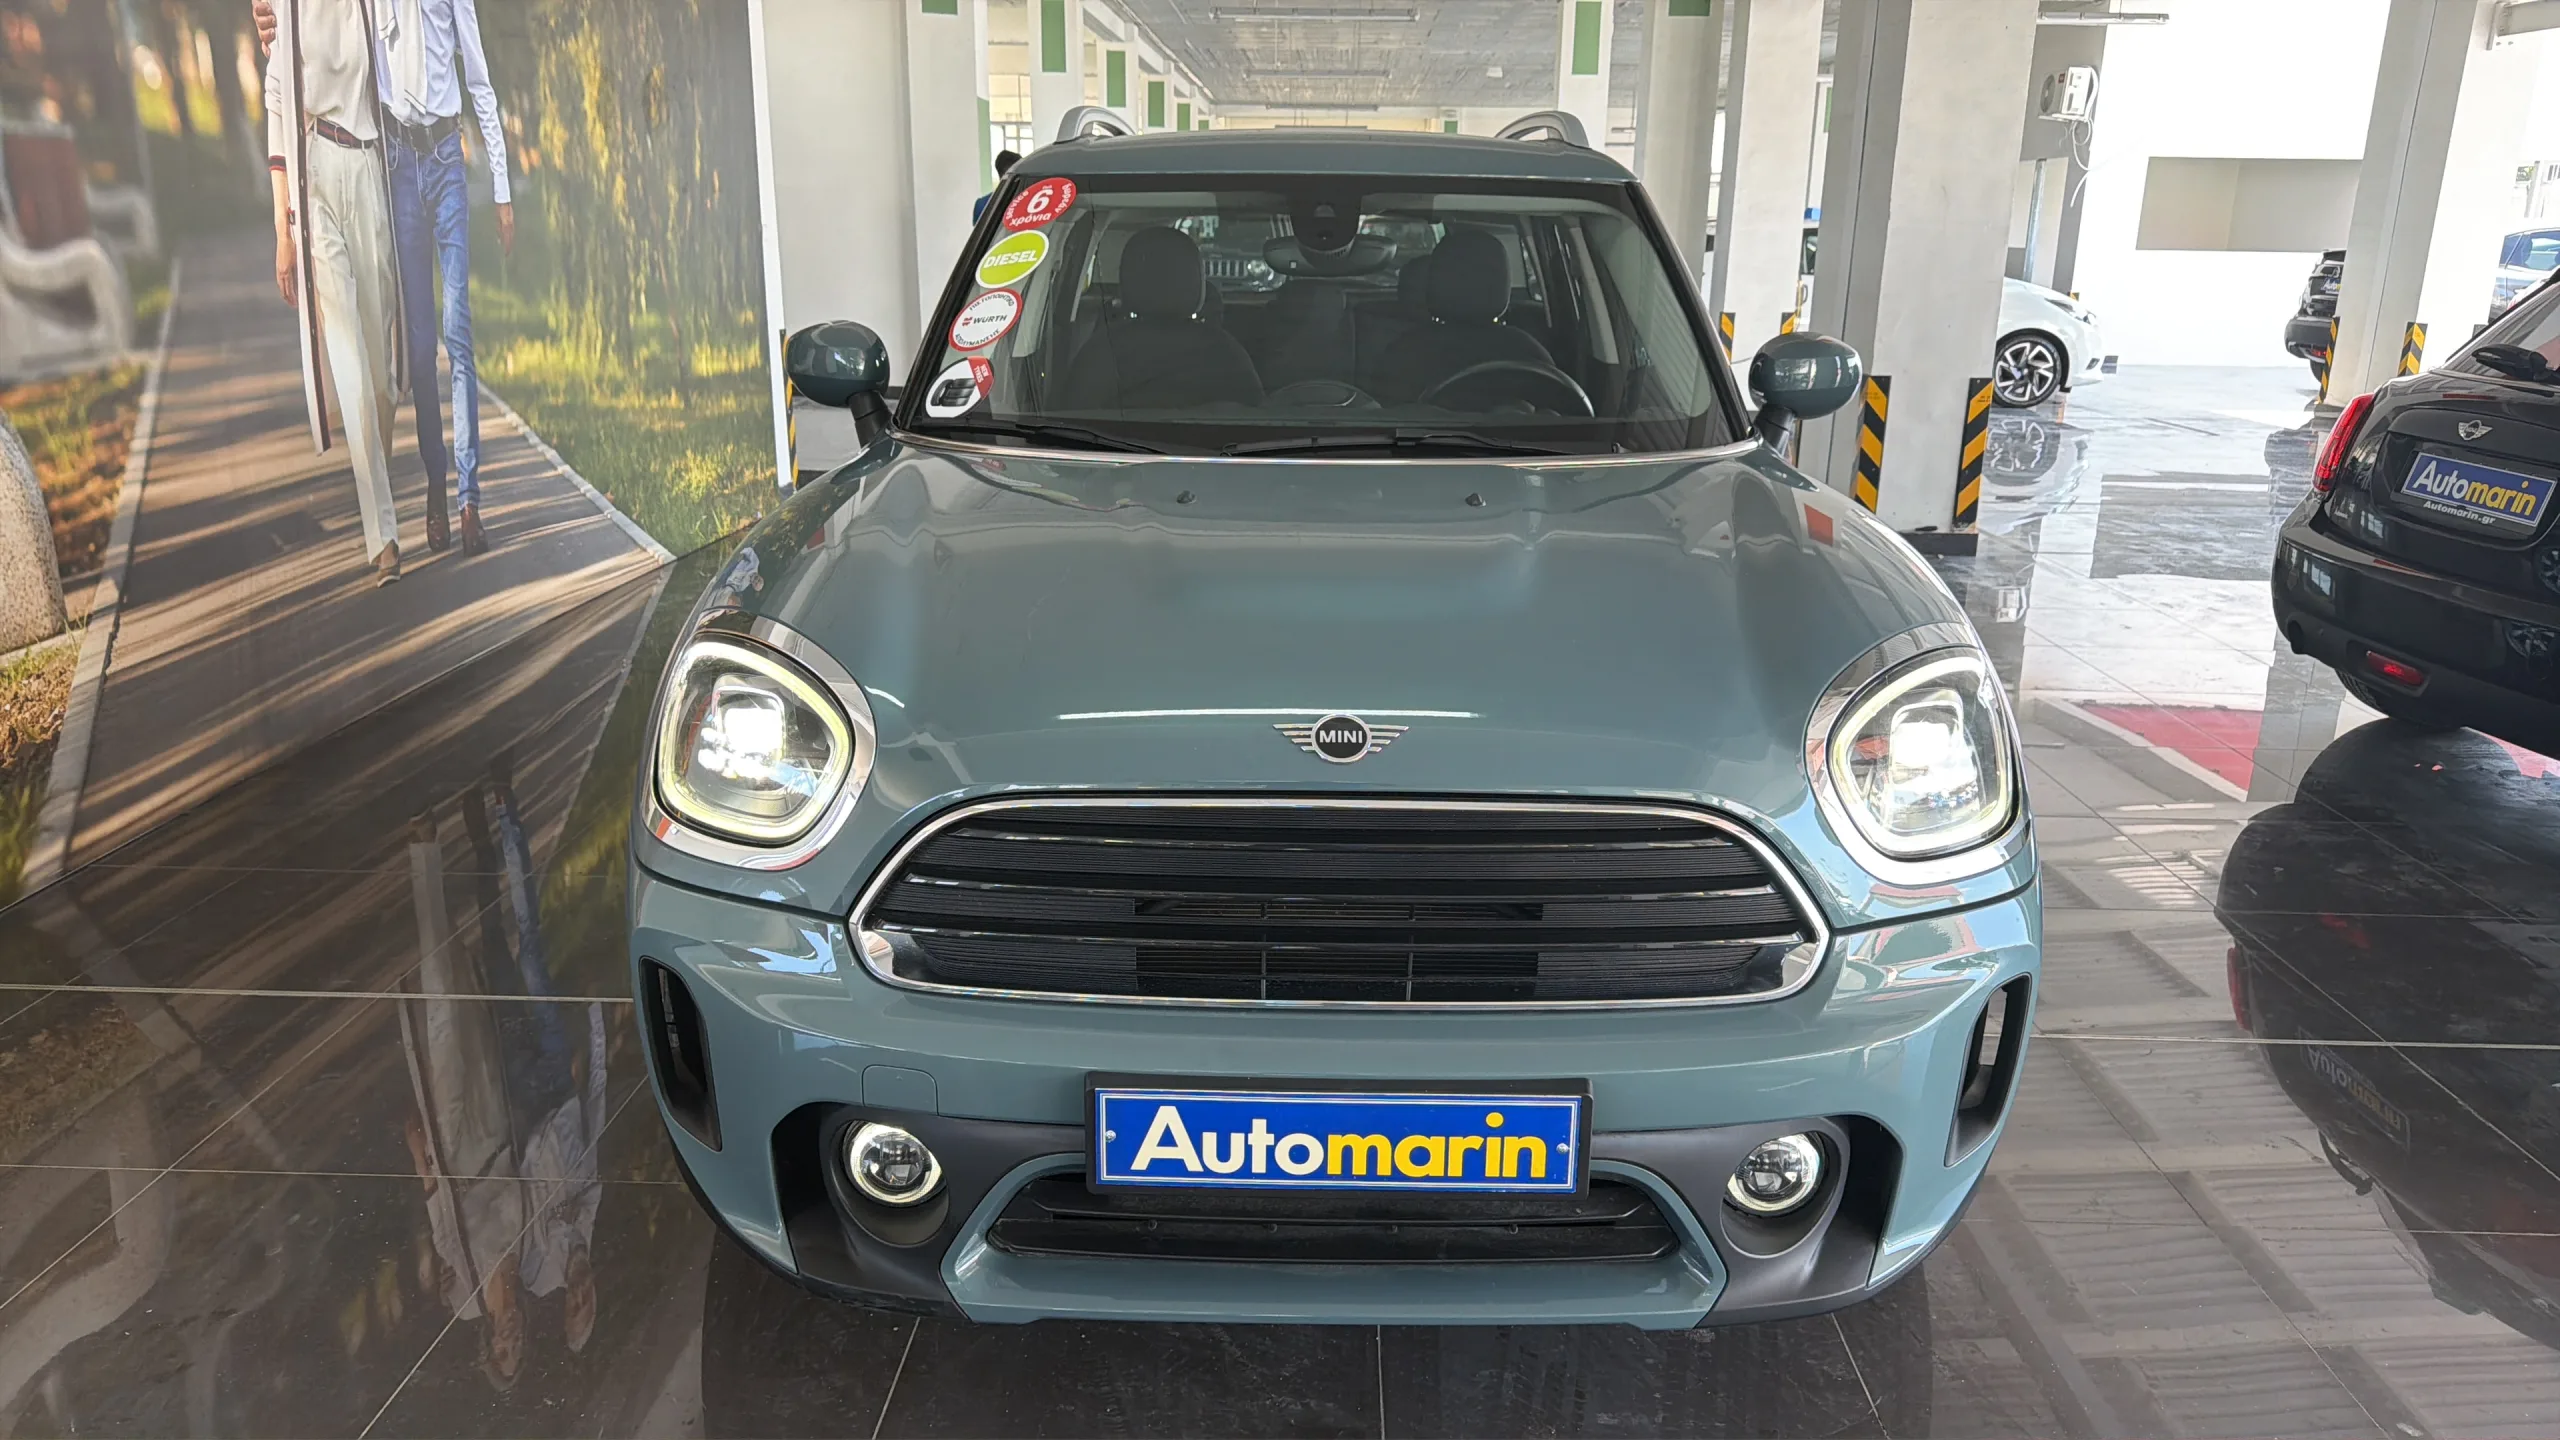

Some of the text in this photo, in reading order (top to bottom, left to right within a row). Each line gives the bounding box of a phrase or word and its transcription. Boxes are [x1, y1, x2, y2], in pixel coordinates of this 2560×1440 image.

[1027, 189, 1054, 214] 6
[1009, 212, 1052, 227] χρόνια
[983, 249, 1038, 269] DIESEL
[2412, 460, 2537, 516] Automarin
[2423, 500, 2496, 525] Automarin.gr
[1319, 729, 1363, 744] MINI
[1129, 1105, 1547, 1179] Automarin
